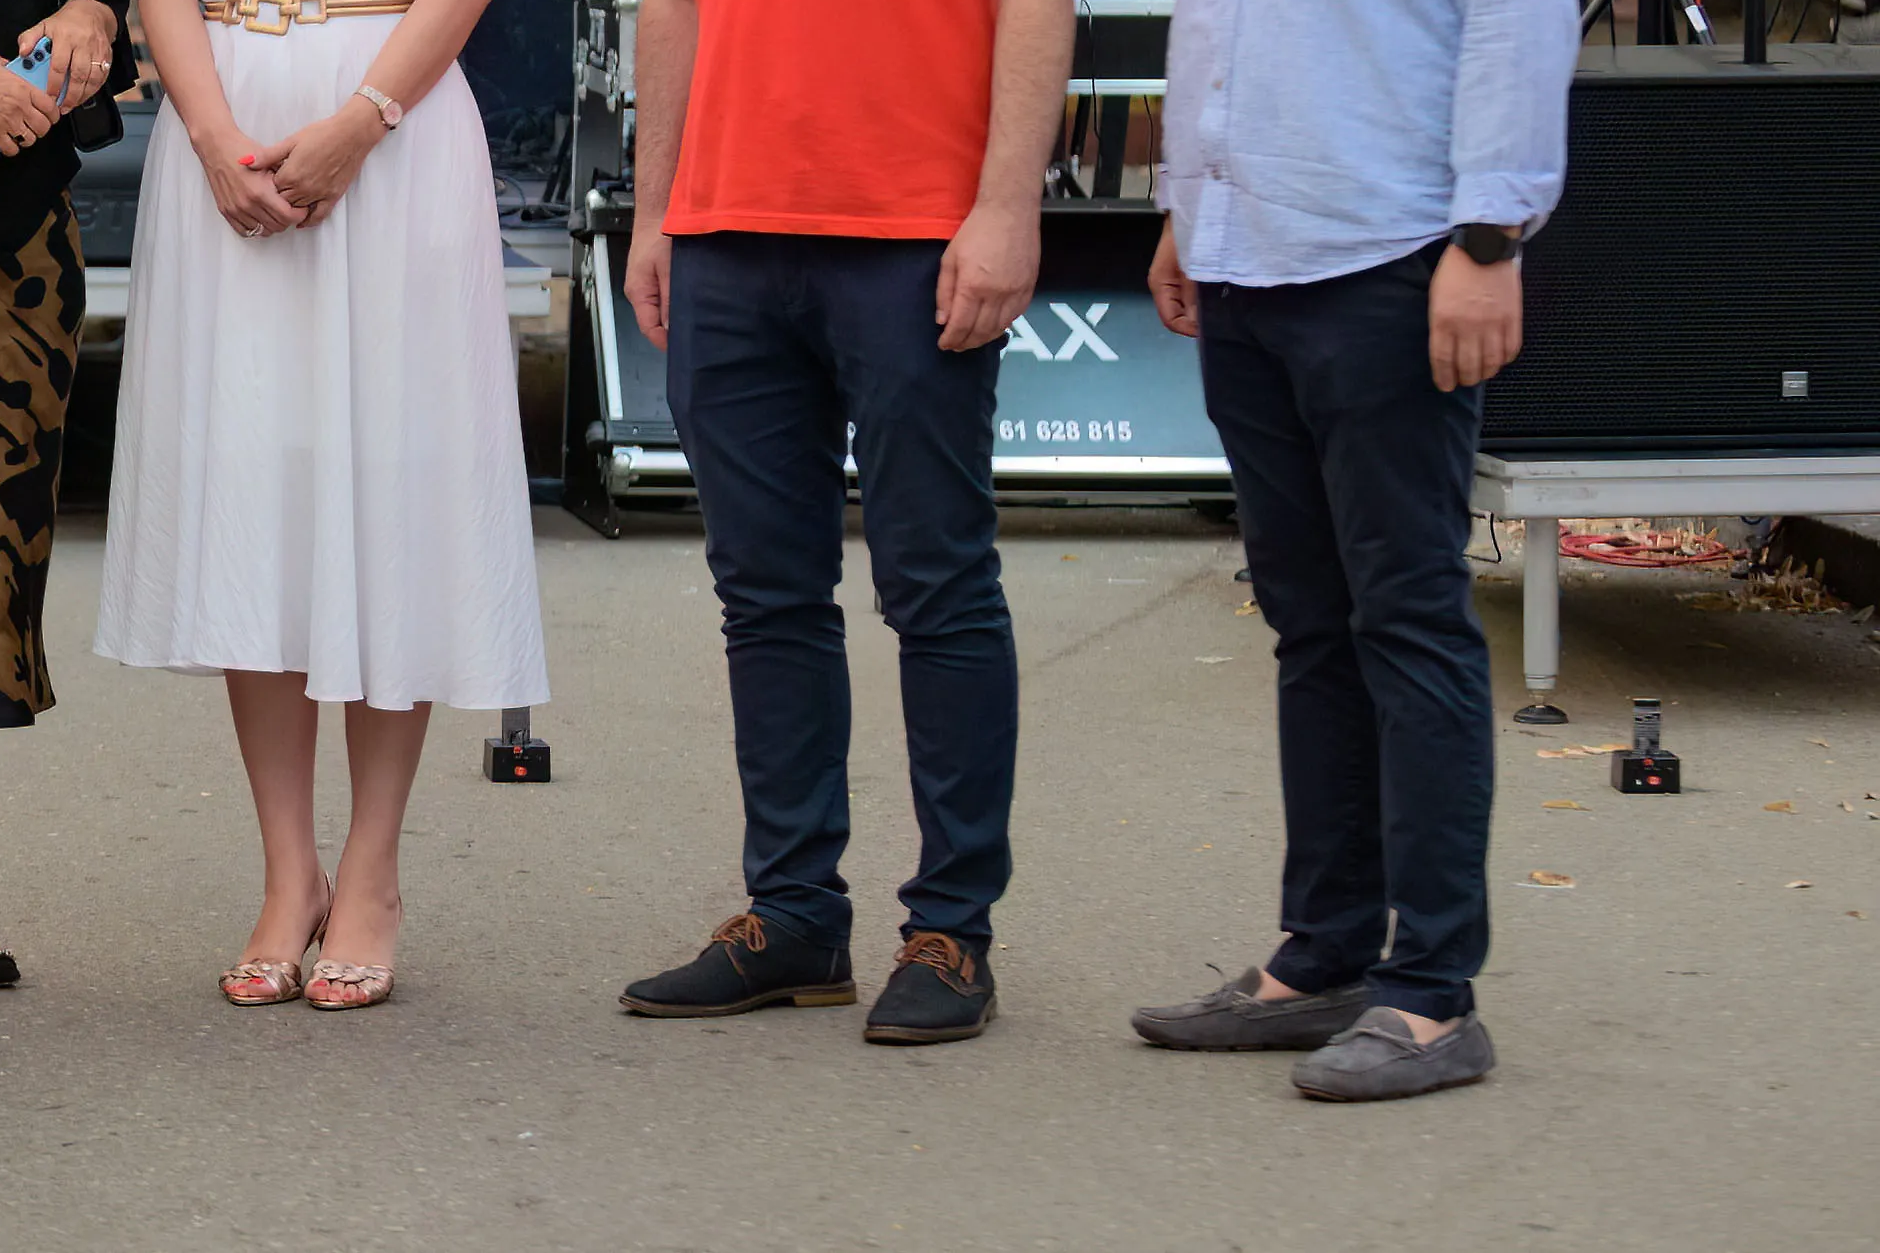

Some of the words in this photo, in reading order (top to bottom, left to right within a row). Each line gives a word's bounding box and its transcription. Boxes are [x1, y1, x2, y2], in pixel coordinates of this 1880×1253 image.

[999, 420, 1026, 442] 61
[1036, 420, 1080, 442] 628
[1088, 420, 1132, 442] 815
